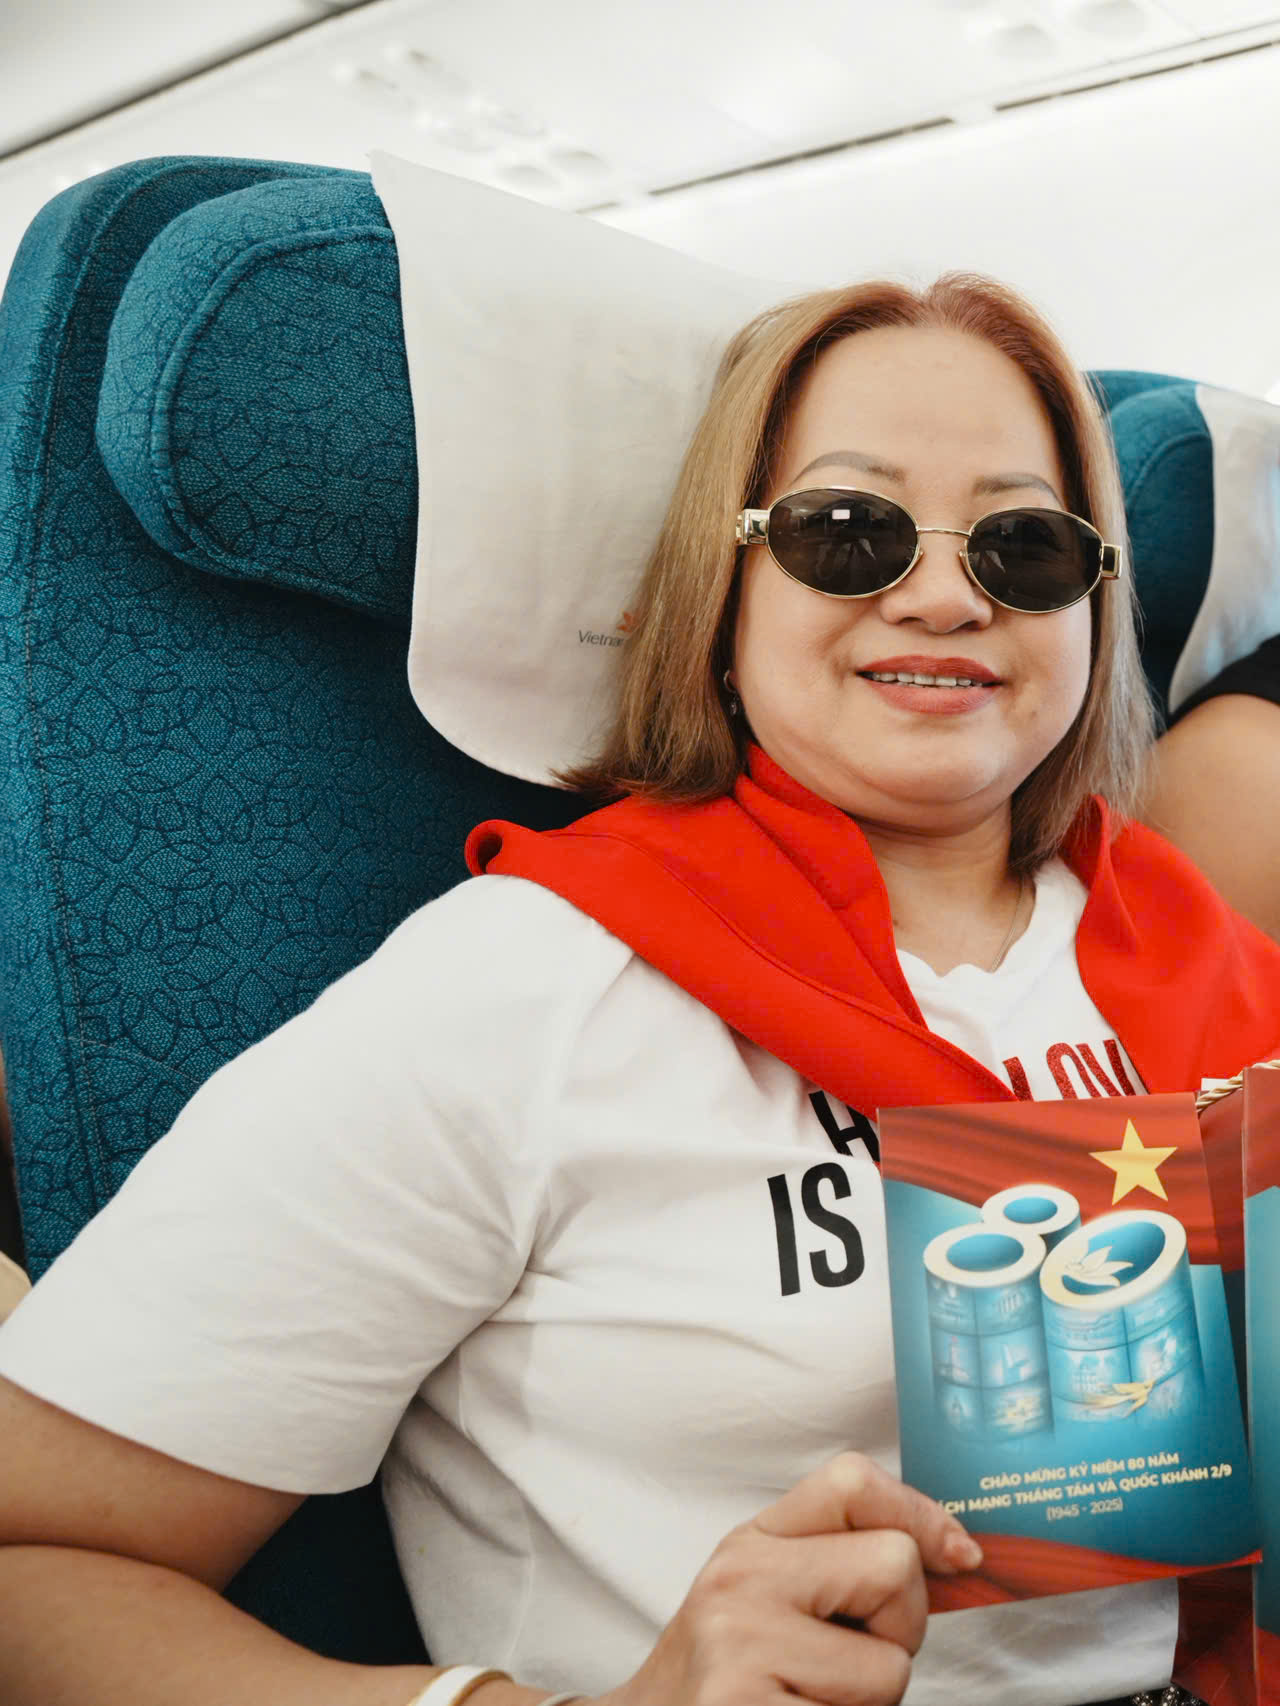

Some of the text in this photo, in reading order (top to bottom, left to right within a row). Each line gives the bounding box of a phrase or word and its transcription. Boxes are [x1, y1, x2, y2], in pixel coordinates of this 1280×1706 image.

[767, 1162, 865, 1296] IS
[980, 1474, 1022, 1490] CHÀO
[1127, 1457, 1146, 1471] 80
[1014, 1487, 1062, 1505] THÁNG
[1097, 1477, 1118, 1493] VÀ
[1161, 1466, 1208, 1484] KHÁNH
[1210, 1464, 1232, 1479] 2/9
